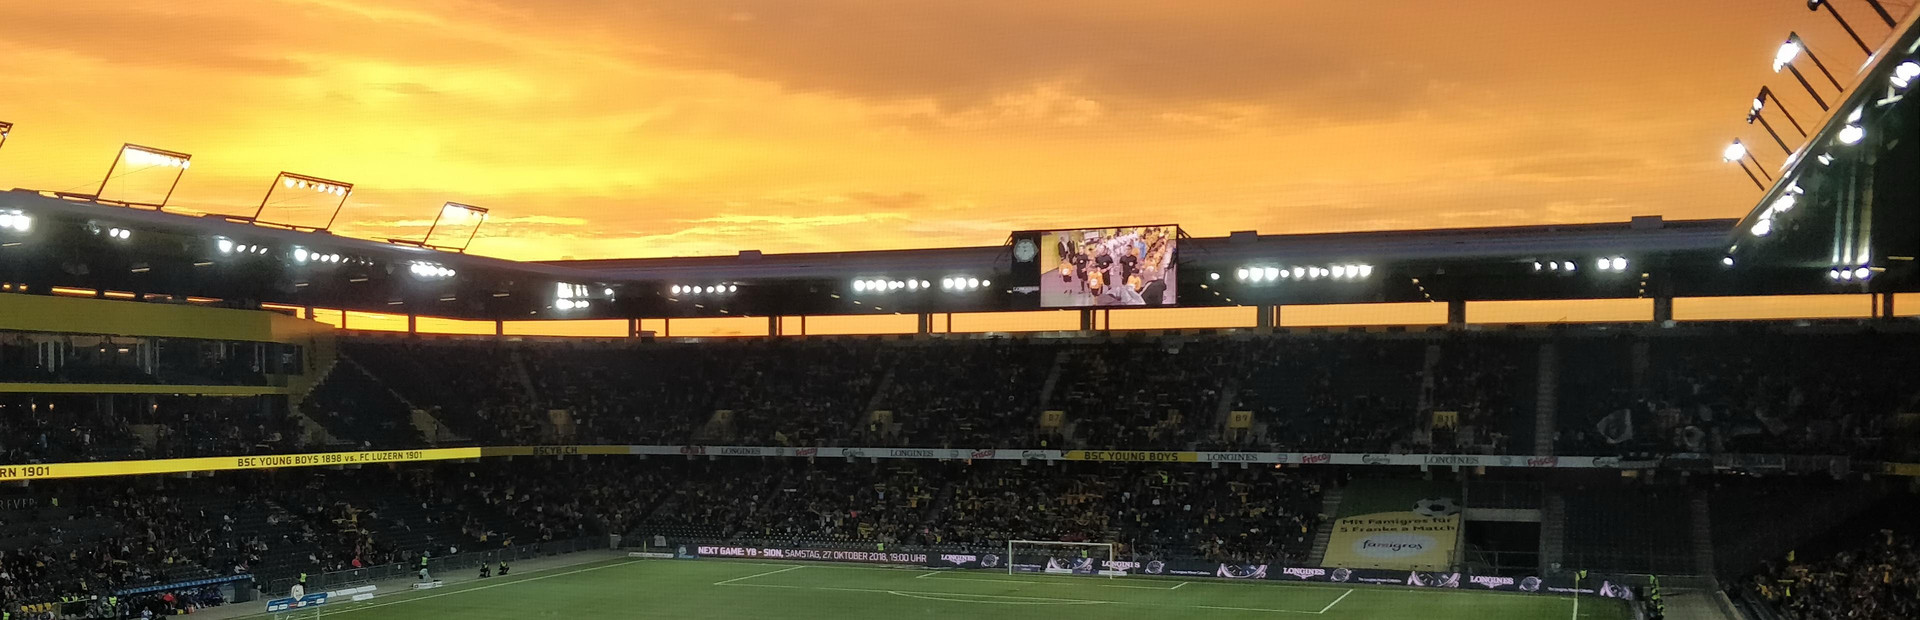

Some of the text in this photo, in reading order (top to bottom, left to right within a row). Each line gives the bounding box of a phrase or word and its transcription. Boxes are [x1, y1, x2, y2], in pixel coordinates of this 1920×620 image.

[720, 447, 761, 455] LONGINES
[890, 449, 934, 457] LONGINES
[237, 458, 257, 467] BSC
[259, 456, 292, 466] YOUNG
[295, 455, 319, 464] BOYS
[321, 454, 342, 463] 1898
[359, 453, 370, 461] FC
[371, 451, 403, 461] LUZERN
[405, 451, 423, 460] 1901
[1083, 451, 1179, 461] BSC YOUNG BOYS
[1206, 453, 1258, 461] LONGINES
[1301, 453, 1329, 464] Frisco
[1423, 455, 1480, 464] LONGINES
[0, 466, 50, 478] RN 1901
[1368, 518, 1429, 527] Famigros
[1362, 539, 1423, 551] famigros
[698, 546, 719, 555] NEXT
[720, 546, 745, 556] GAME:
[746, 547, 757, 556] YB
[764, 548, 784, 558] SION,
[785, 550, 821, 560] SAMSTAG,
[834, 551, 868, 560] OKTOBER
[869, 553, 888, 562] 2018,
[890, 552, 909, 562] 19:00
[910, 553, 927, 563] UHR
[1283, 567, 1325, 575] LONGINES
[1470, 575, 1514, 584] LONGINES
